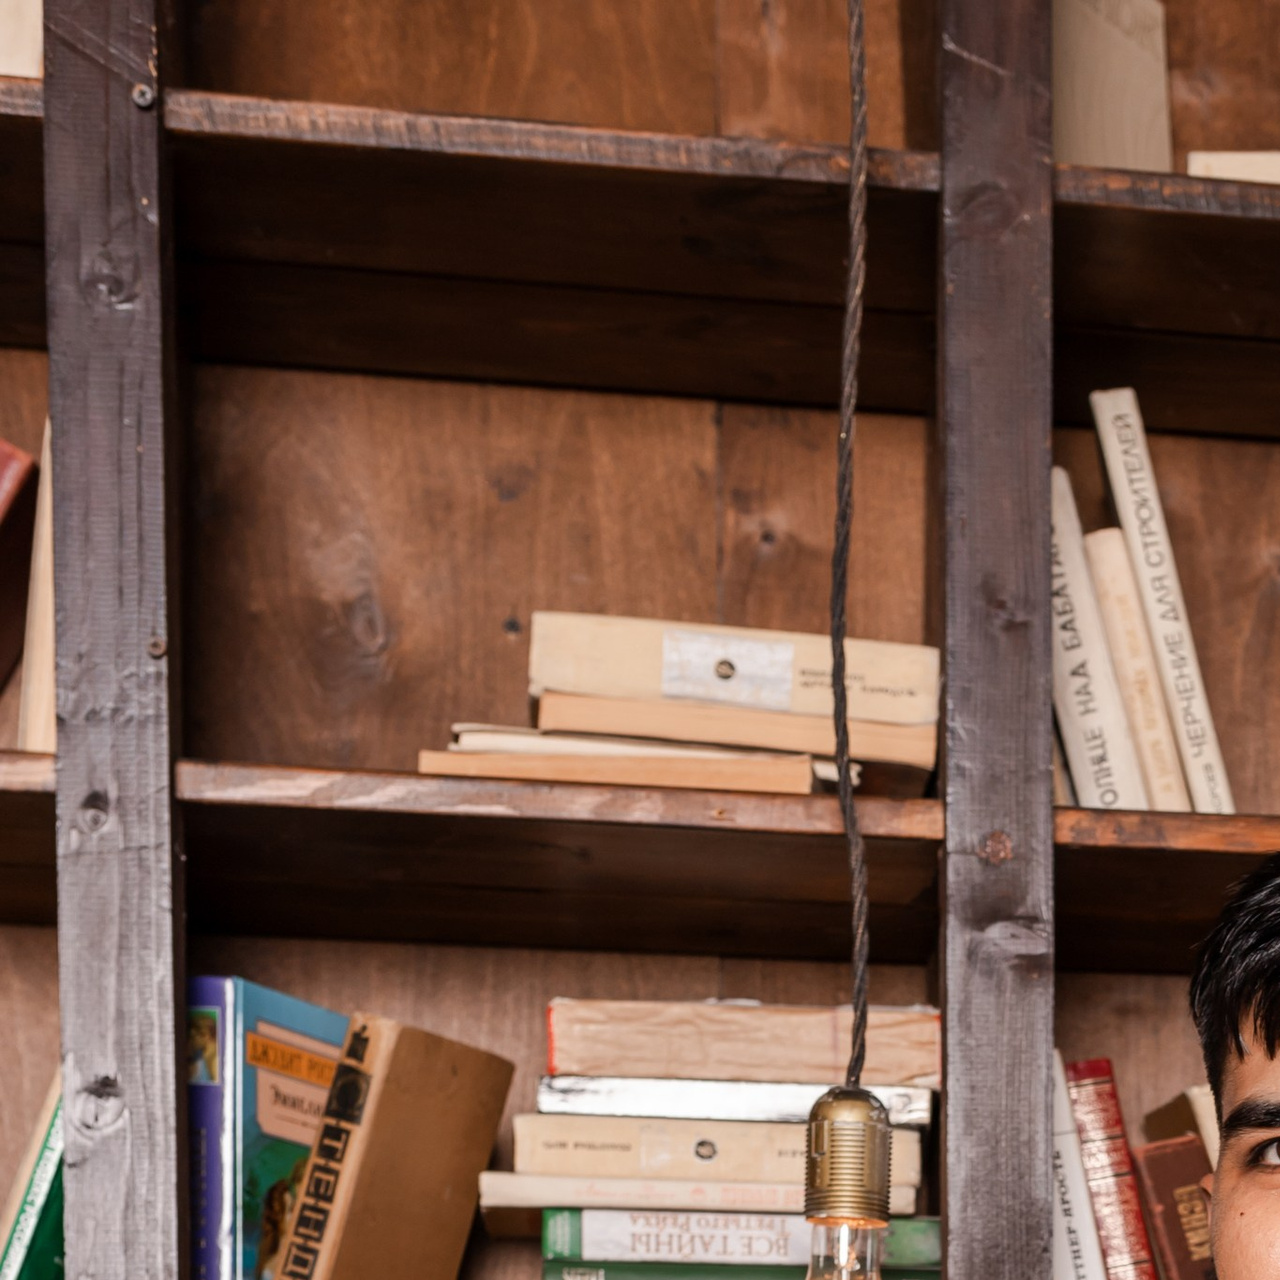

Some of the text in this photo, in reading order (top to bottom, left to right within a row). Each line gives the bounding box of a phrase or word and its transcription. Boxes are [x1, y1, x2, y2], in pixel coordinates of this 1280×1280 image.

[1106, 410, 1168, 571] СТРОИТЕЛЕЙ
[1148, 570, 1181, 626] ДЛЯ
[1161, 628, 1213, 758] ЧЕРЧЕНИЕ
[1083, 724, 1120, 808] ОЛНЦЕ
[629, 1233, 789, 1258] ВСЕ ТАЙНЫ
